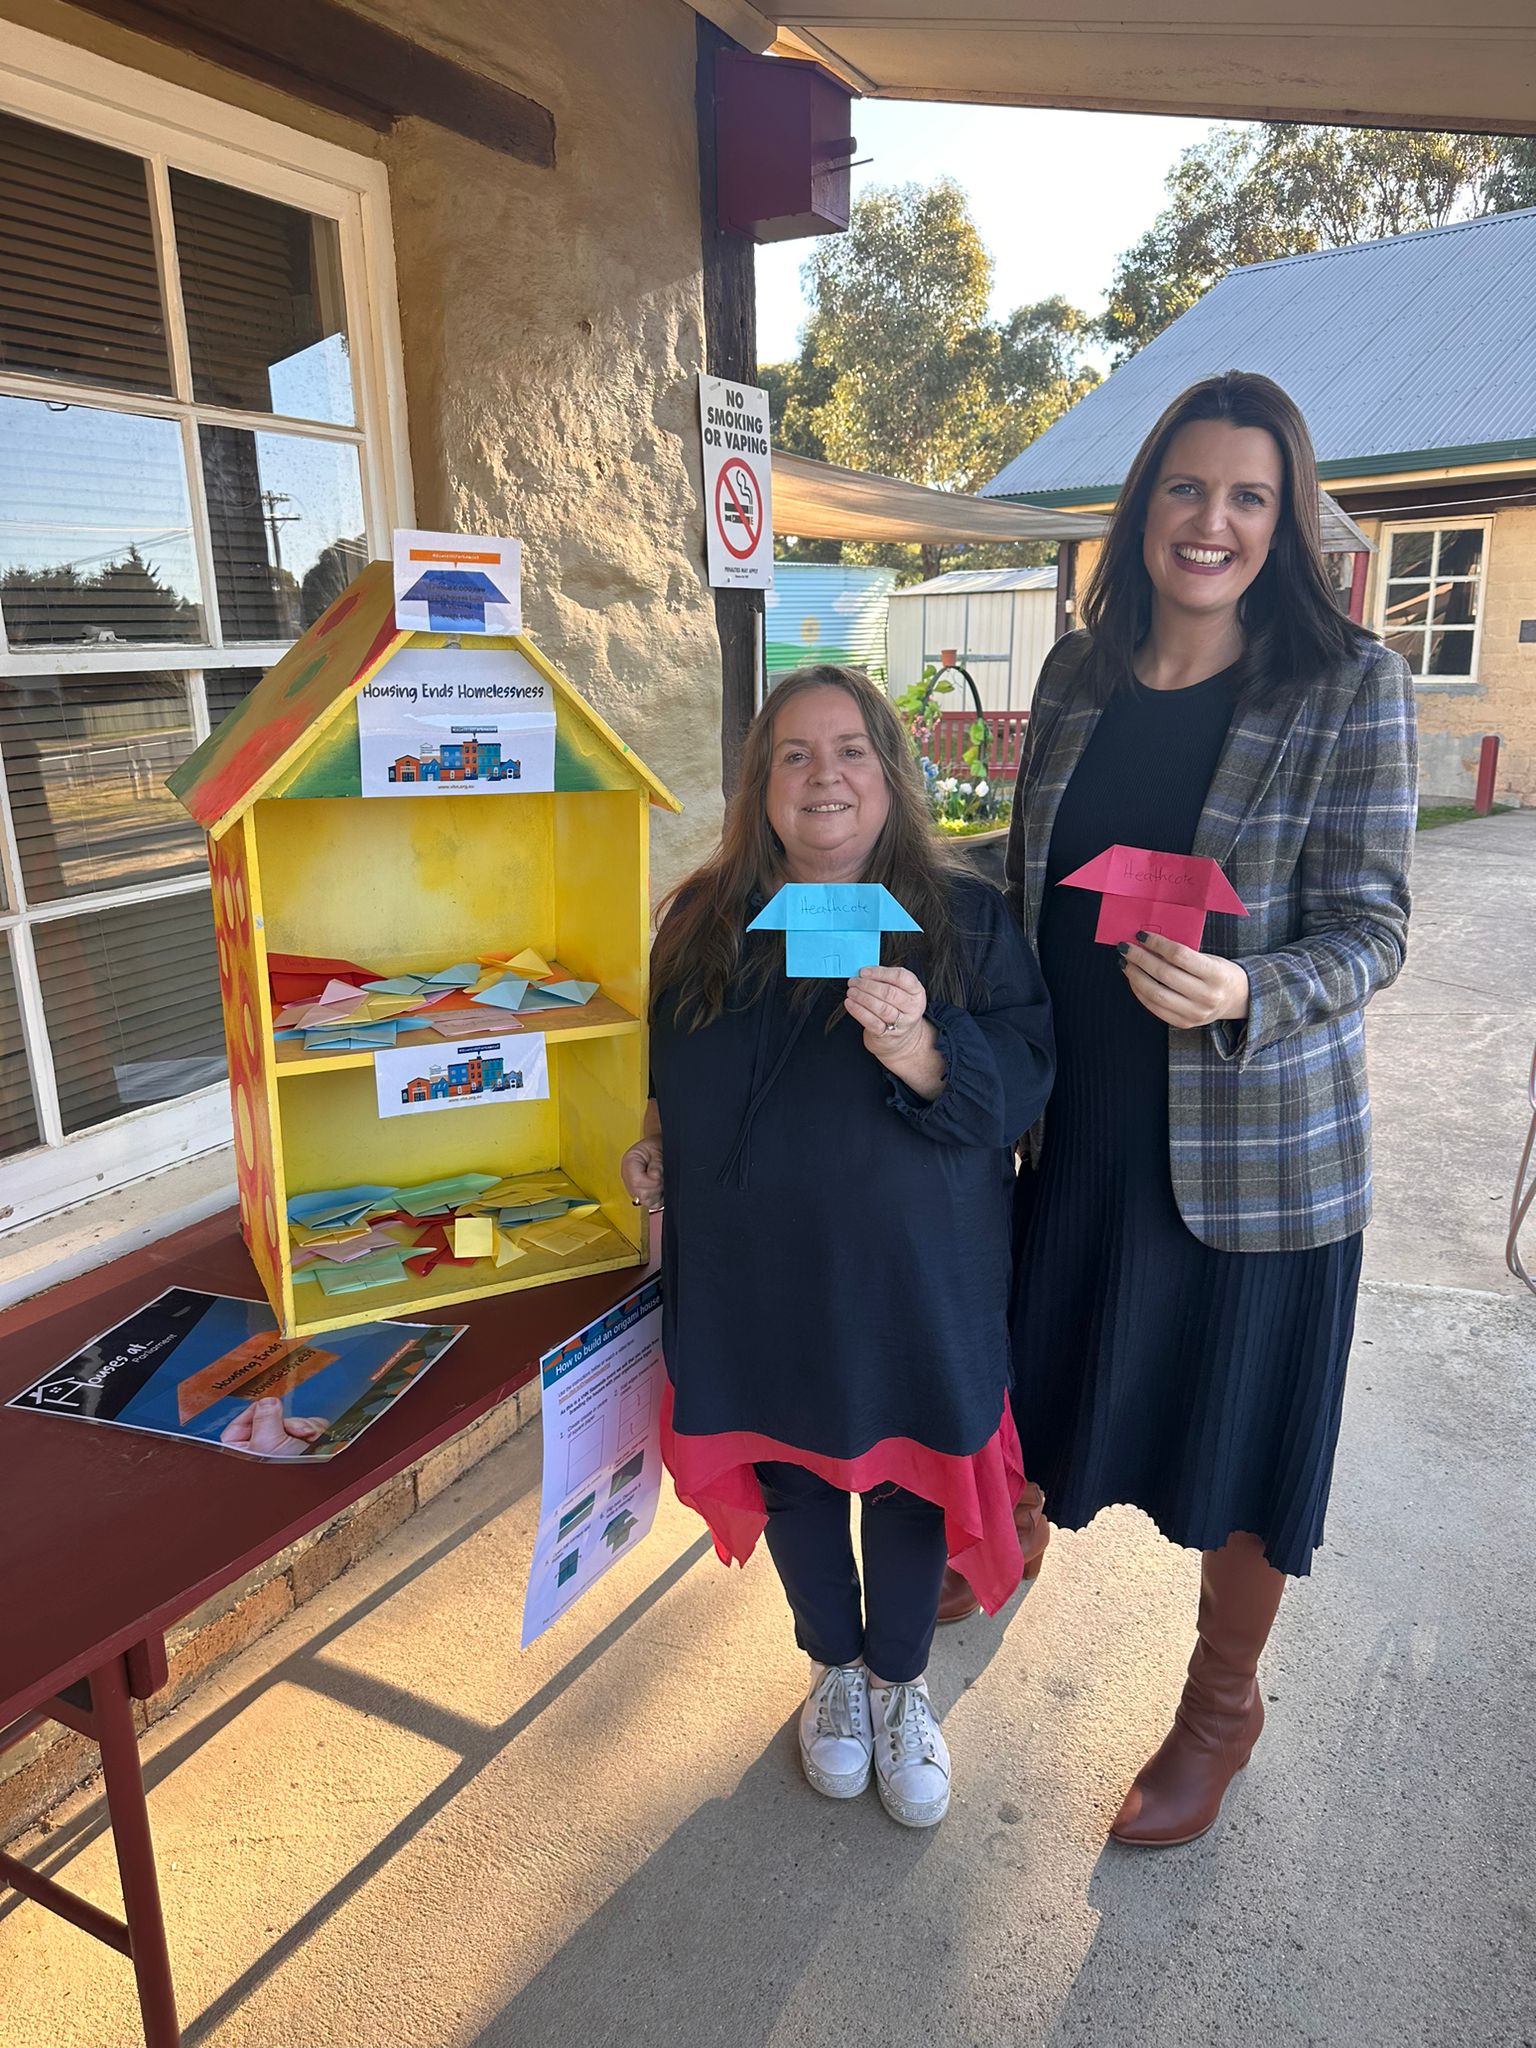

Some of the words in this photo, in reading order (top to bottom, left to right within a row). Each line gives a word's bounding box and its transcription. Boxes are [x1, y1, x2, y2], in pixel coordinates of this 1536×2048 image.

[726, 389, 744, 409] NO
[707, 406, 763, 434] SMOKING
[704, 427, 722, 447] OR
[724, 431, 768, 456] VAPING
[363, 683, 418, 704] Housing
[422, 683, 454, 698] Ends
[458, 684, 545, 699] Homelessness
[1123, 859, 1196, 886] Heathcote
[800, 896, 870, 915] Heathcote
[131, 1333, 178, 1363] Parliament
[555, 1358, 574, 1375] How
[574, 1351, 582, 1362] to
[583, 1335, 602, 1356] build
[602, 1330, 613, 1341] an
[613, 1308, 639, 1333] origami
[640, 1295, 660, 1315] house
[212, 1360, 263, 1390] Housing
[253, 1342, 282, 1361] Ends
[248, 1349, 316, 1396] Homelessness
